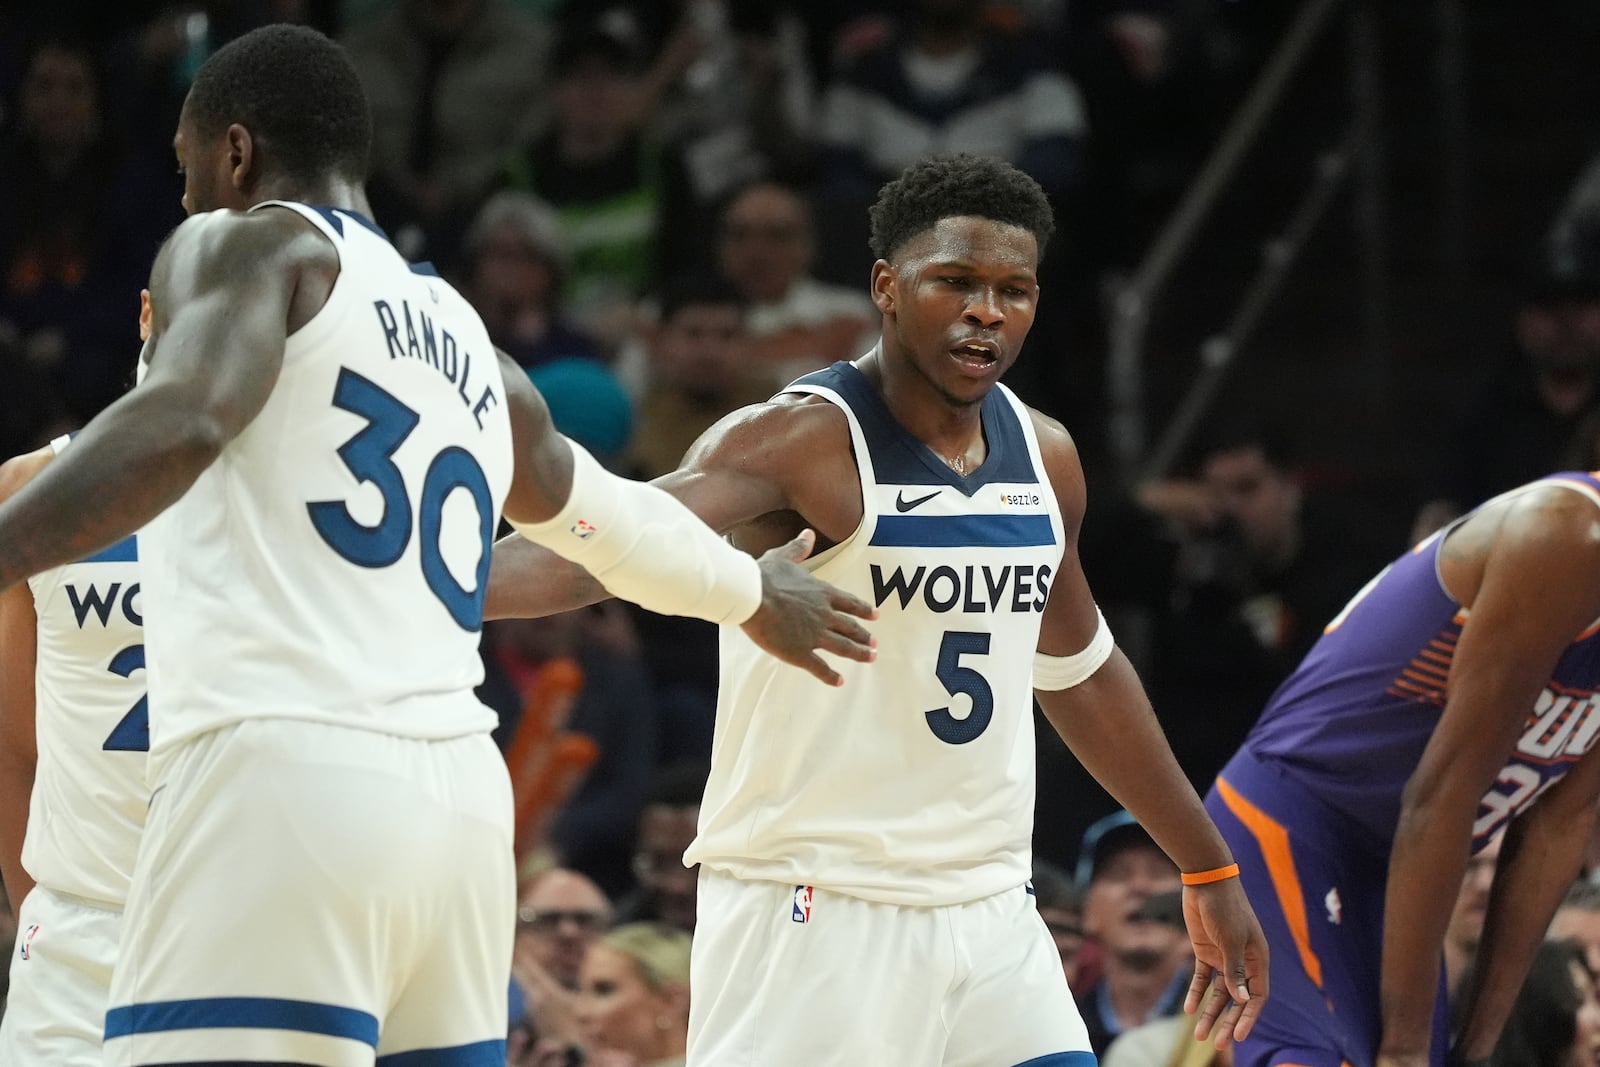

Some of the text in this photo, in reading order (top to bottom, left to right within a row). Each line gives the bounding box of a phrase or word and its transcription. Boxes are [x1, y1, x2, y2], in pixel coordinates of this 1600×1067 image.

[374, 299, 498, 432] RANDLE
[306, 365, 494, 633] 30
[1007, 491, 1040, 506] sezzle
[869, 563, 1052, 614] WOLVES
[924, 630, 994, 745] 5
